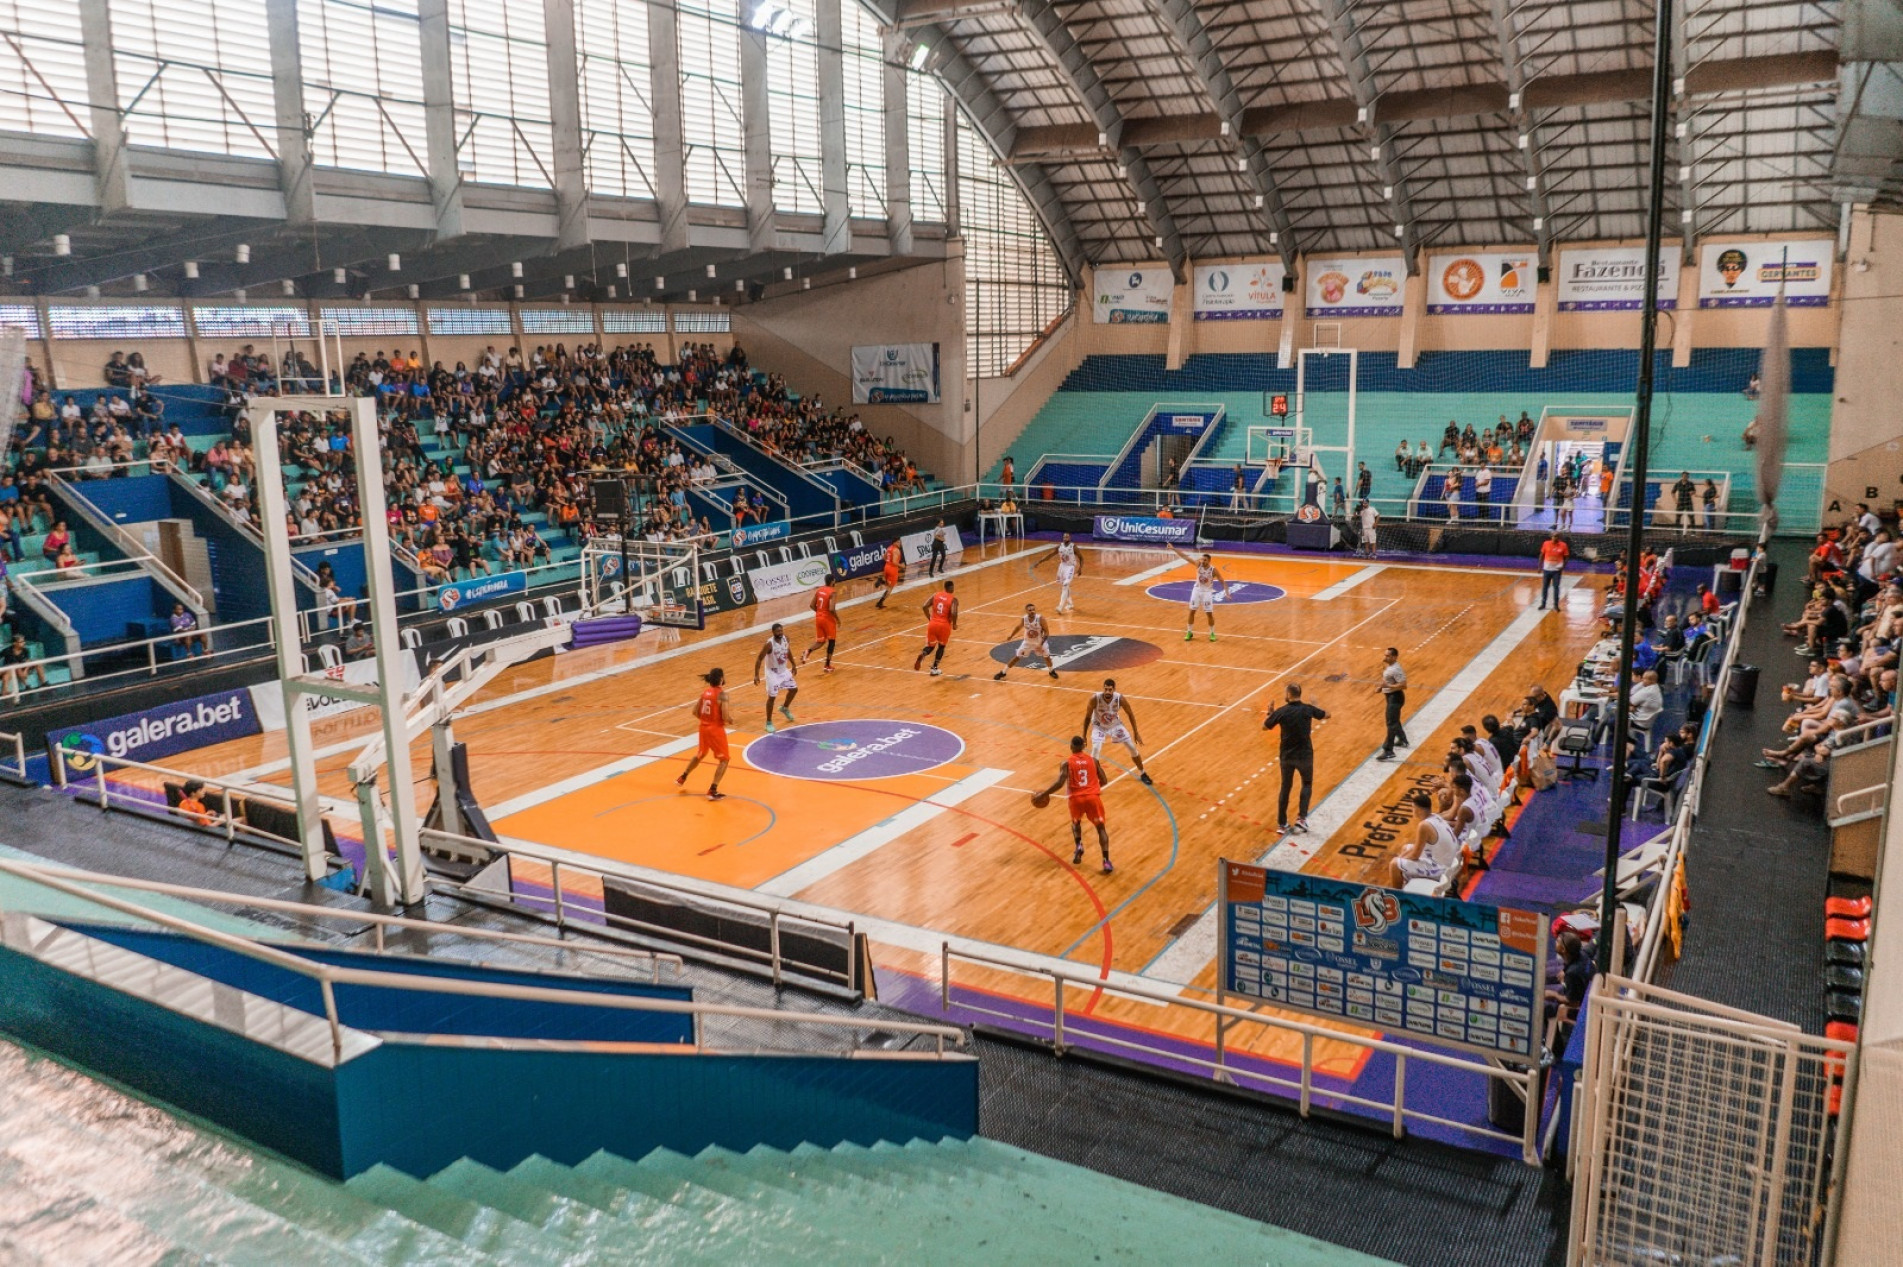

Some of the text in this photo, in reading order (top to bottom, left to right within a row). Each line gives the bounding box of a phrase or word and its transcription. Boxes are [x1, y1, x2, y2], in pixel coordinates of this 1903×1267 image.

[1865, 486, 1879, 499] B
[1827, 500, 1842, 512] A
[1120, 521, 1189, 537] UniCesumar
[849, 544, 889, 571] galera.b
[936, 602, 944, 615] 9
[107, 696, 241, 756] galera.bet
[816, 727, 923, 774] galera.bet
[1078, 769, 1088, 787] 3
